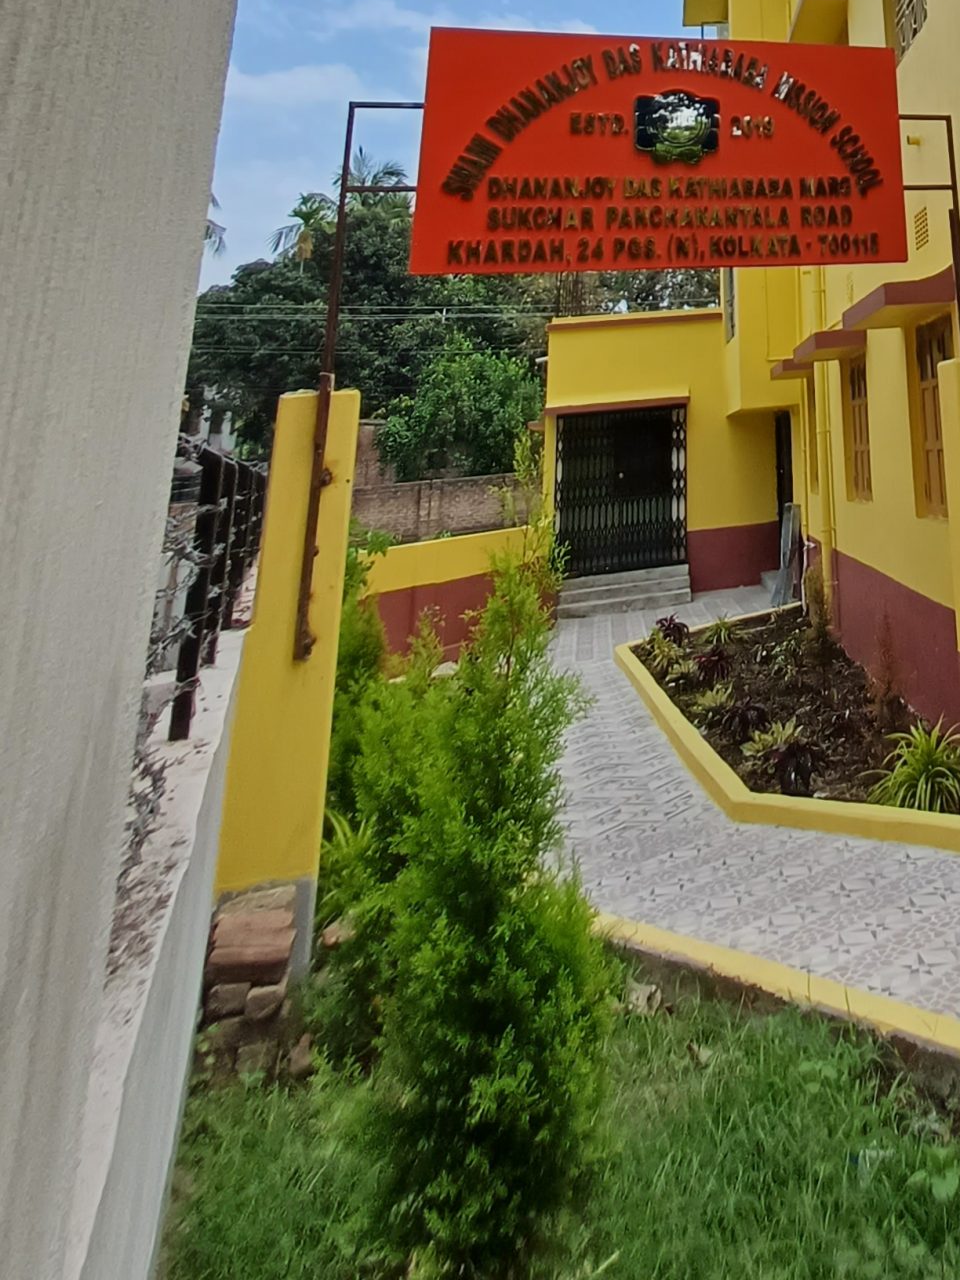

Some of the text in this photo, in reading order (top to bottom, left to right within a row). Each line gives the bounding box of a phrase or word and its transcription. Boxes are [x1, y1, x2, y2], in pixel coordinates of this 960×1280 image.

[441, 132, 503, 202] SWAMI
[602, 43, 642, 81] DAS
[771, 70, 841, 135] MISSION
[829, 124, 883, 198] SCHOOL
[487, 176, 851, 201] DHANANJOY DAS KATHIABABA MARG
[486, 206, 594, 231] SUKCHAR
[801, 205, 853, 229] ROAD
[577, 237, 604, 263] 24
[709, 235, 801, 259] KOLKATA
[818, 233, 879, 257] 700115
